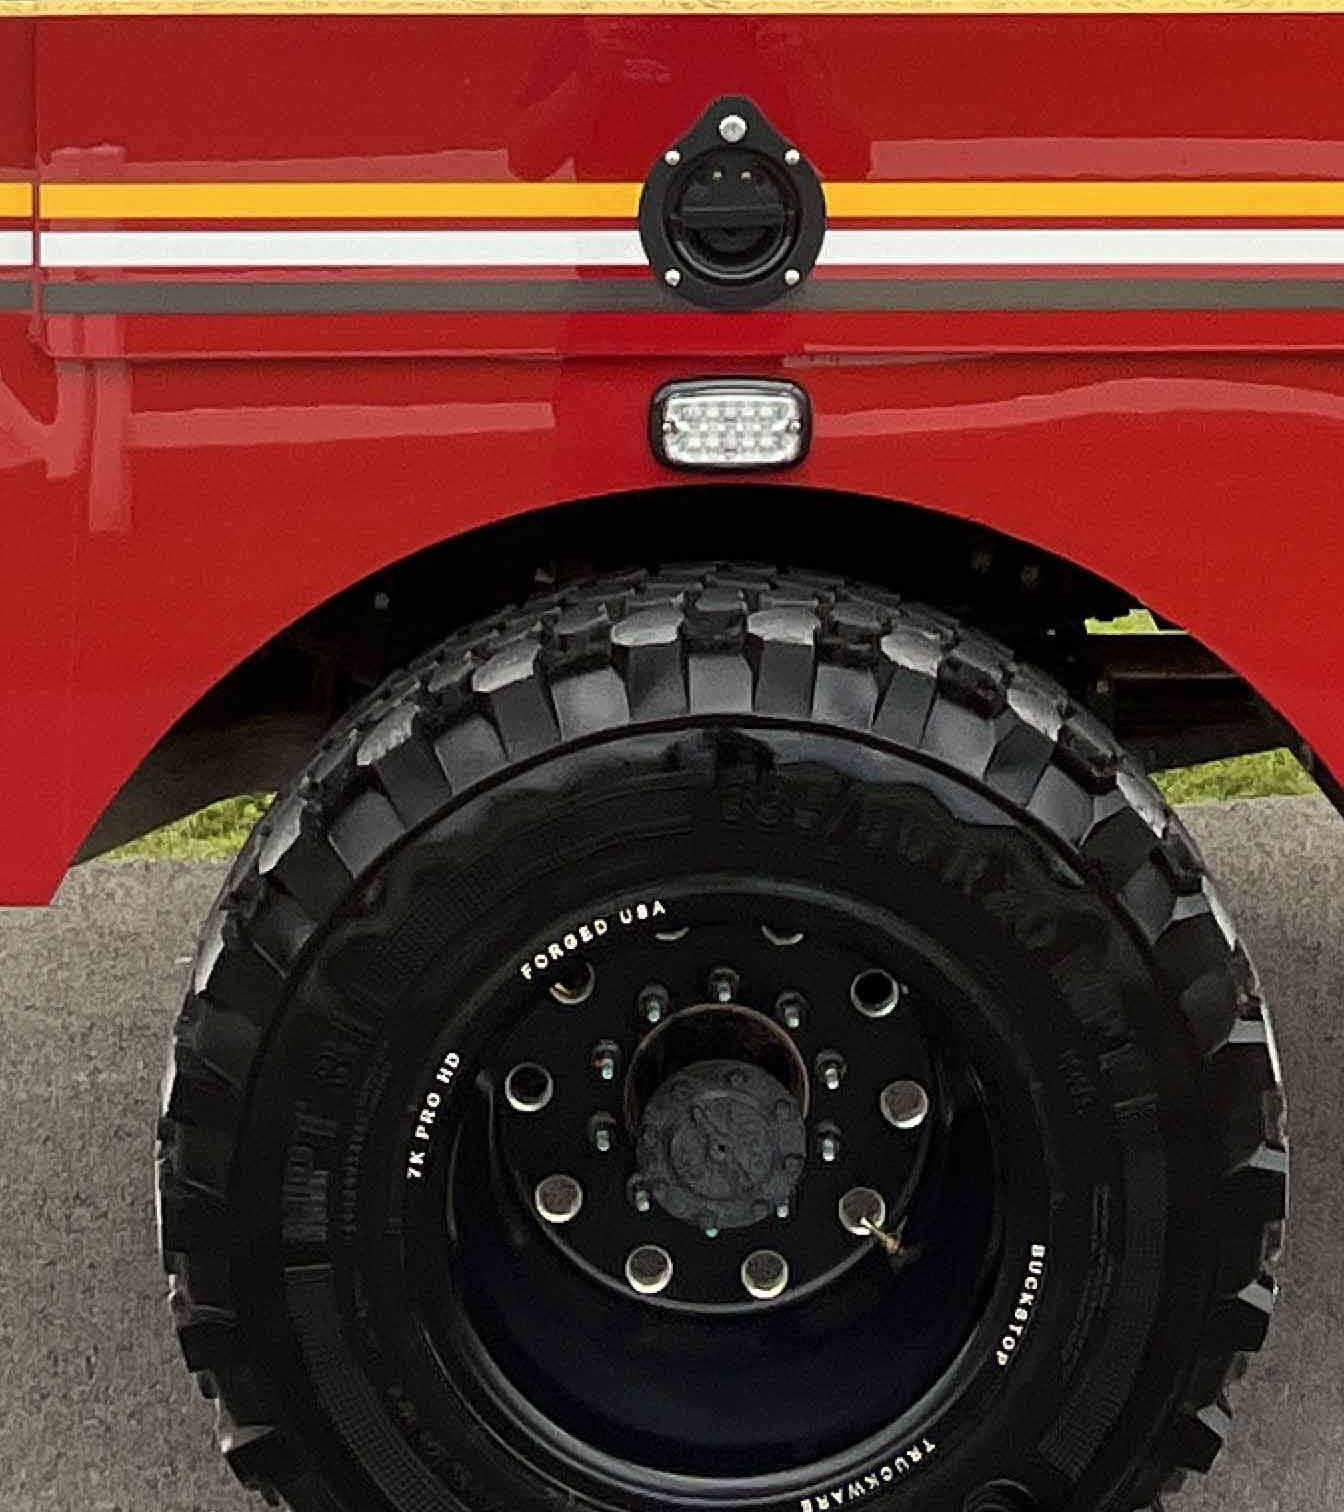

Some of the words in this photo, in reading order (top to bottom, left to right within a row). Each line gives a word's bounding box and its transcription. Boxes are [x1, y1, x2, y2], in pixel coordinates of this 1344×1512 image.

[519, 917, 609, 981] FORGED
[617, 899, 667, 925] USA
[435, 1051, 461, 1085] HD
[413, 1091, 442, 1141] PRO
[405, 1149, 427, 1179] 7K
[995, 1243, 1047, 1367] BUCKSTOP
[799, 1437, 937, 1512] TRUCKWARE
